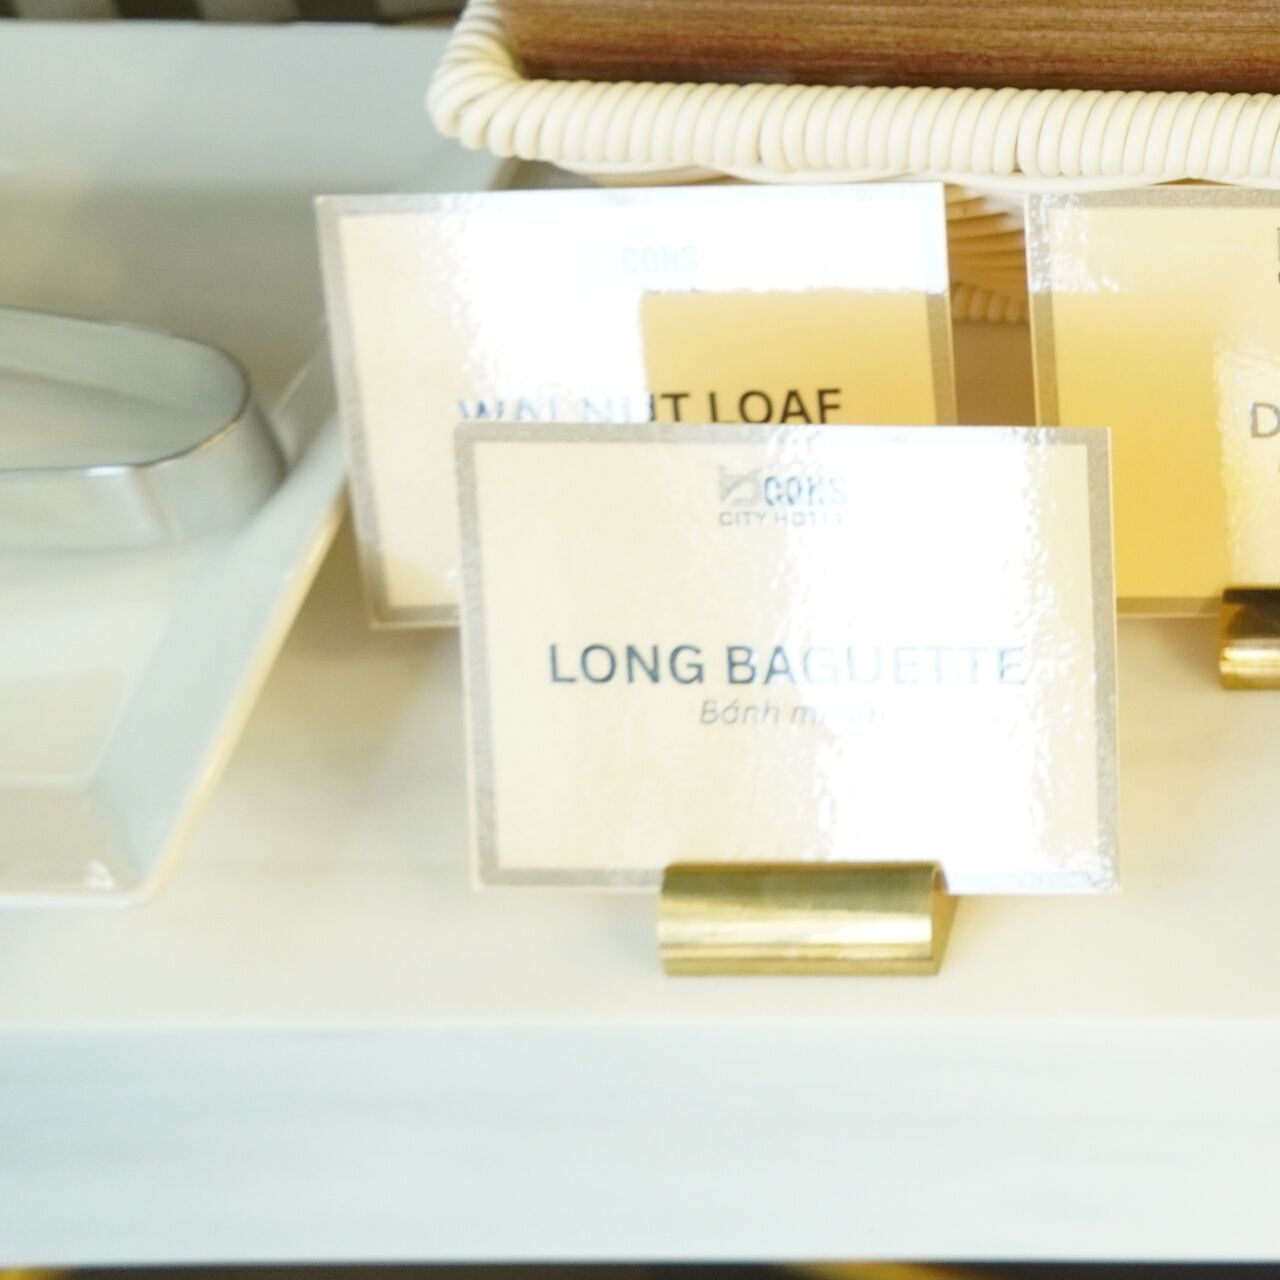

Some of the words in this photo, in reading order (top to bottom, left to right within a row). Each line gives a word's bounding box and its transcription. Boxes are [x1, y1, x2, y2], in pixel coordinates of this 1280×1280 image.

[707, 388, 842, 424] LOAF
[719, 511, 766, 526] CITY
[549, 643, 703, 684] LONG
[726, 643, 1027, 686] BAGUETTE
[700, 699, 780, 724] Bánh
